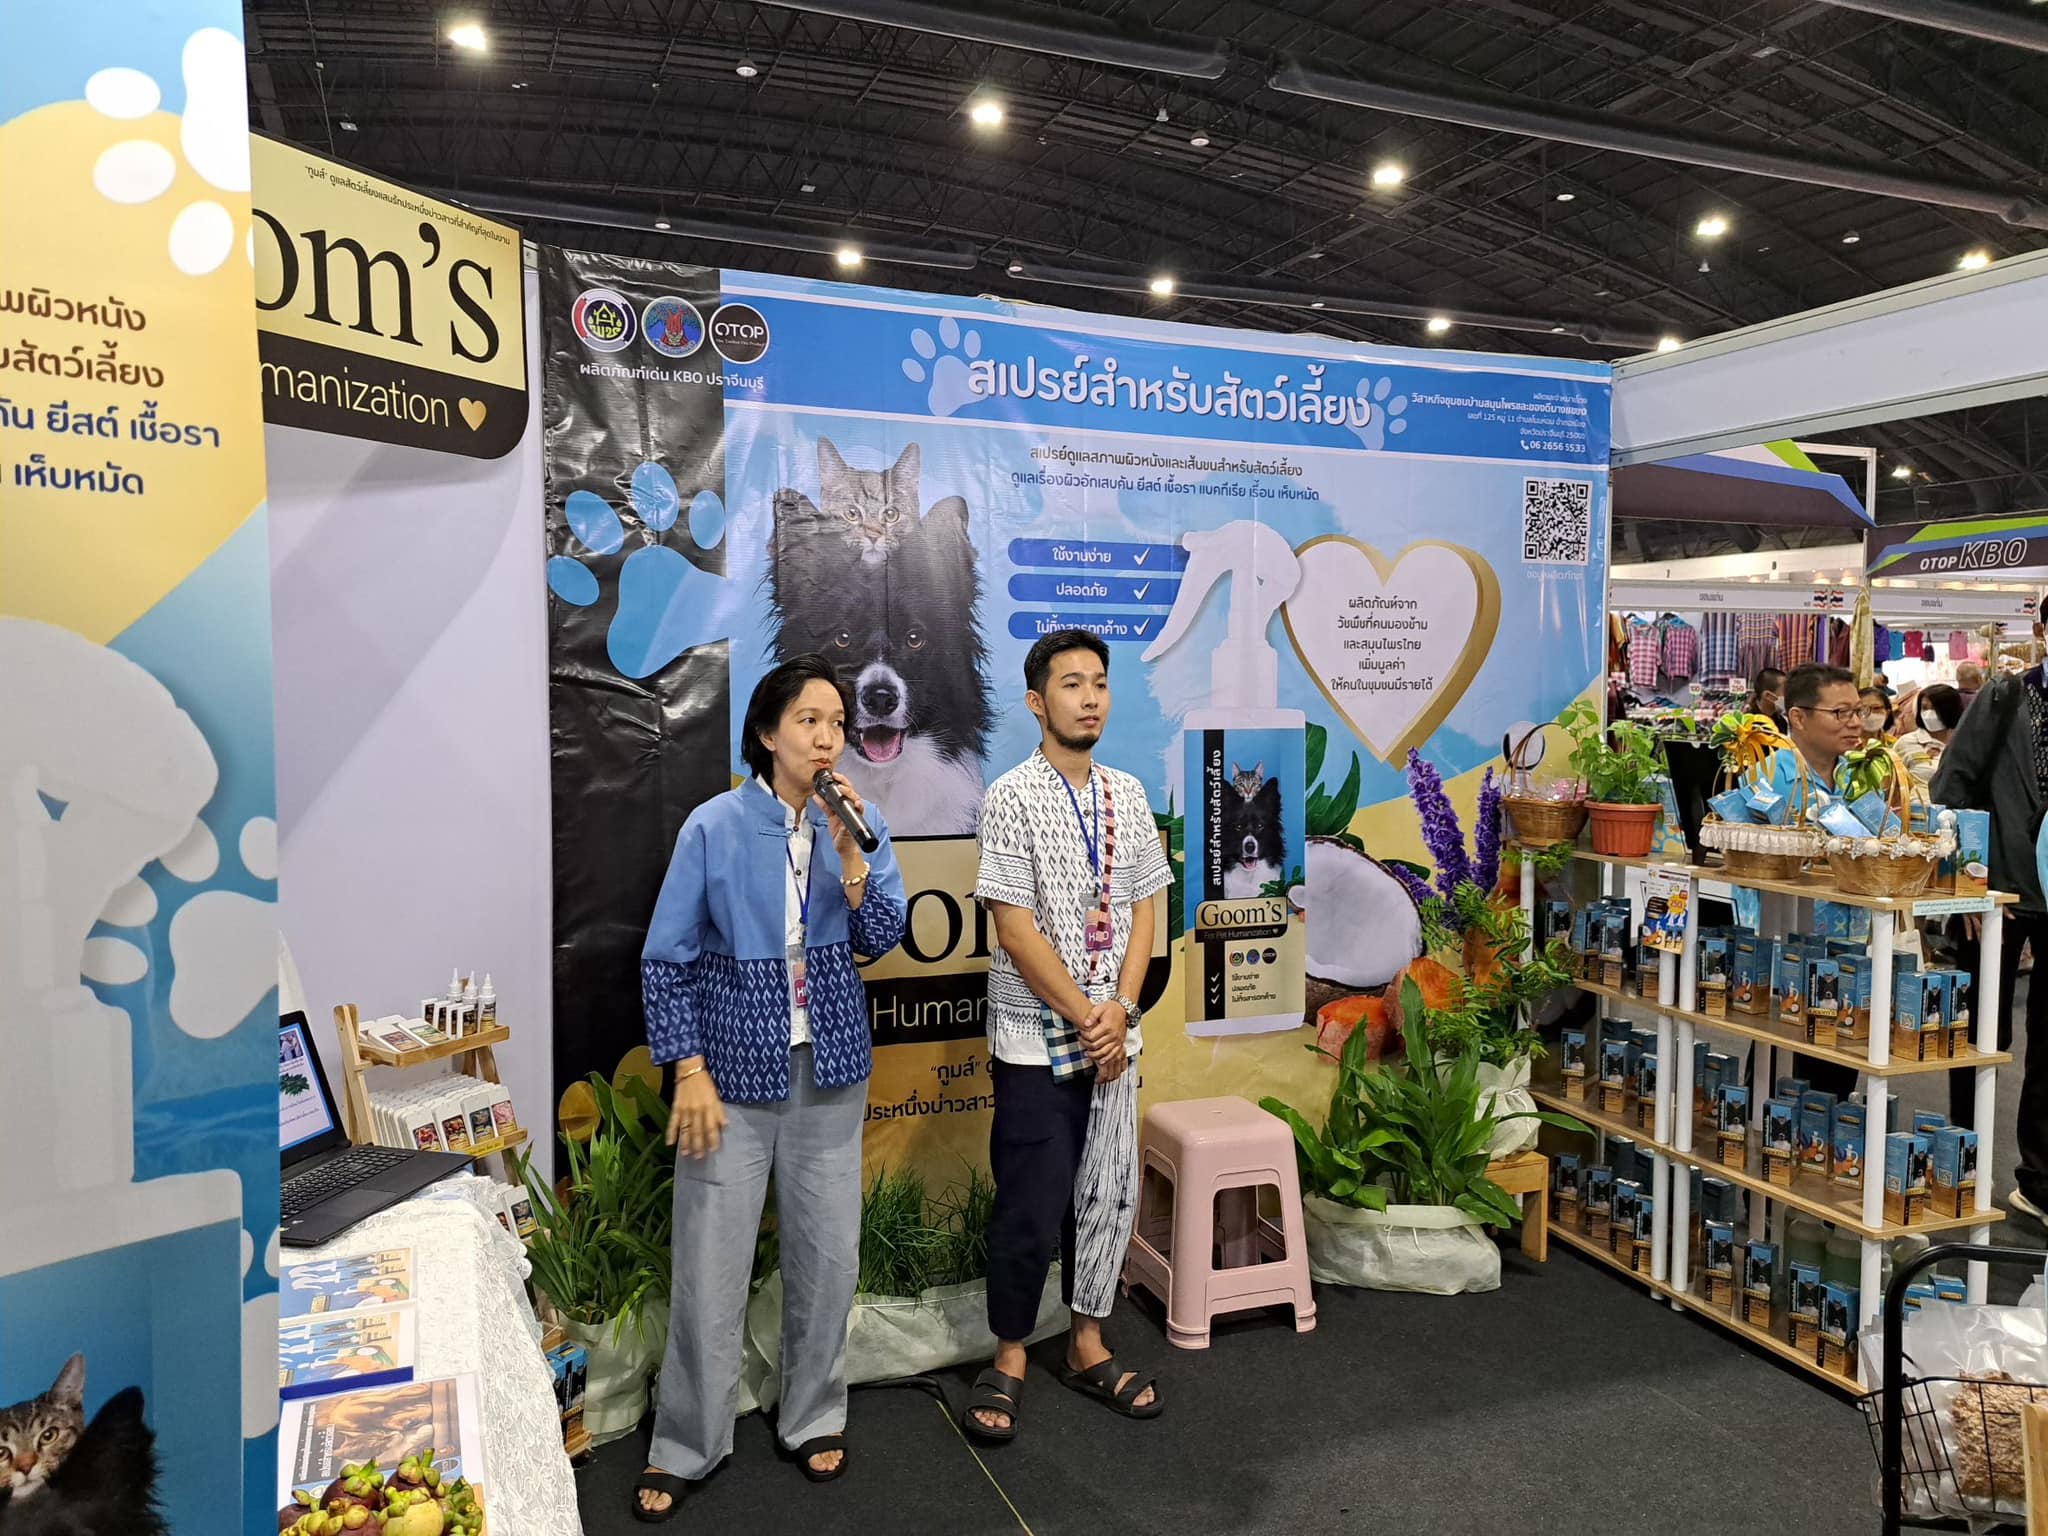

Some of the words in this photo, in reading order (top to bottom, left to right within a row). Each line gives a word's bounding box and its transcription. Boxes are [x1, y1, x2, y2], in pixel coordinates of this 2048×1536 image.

[714, 322, 765, 339] OTOP
[580, 362, 669, 382] ผลิตภัณฑ์เด่น
[673, 370, 704, 384] KBO
[706, 373, 764, 393] ปราจีนบุรี
[967, 354, 1374, 429] สเปรย์สำหรับสัตว์เลี้ยง
[46, 399, 119, 439] ยีสต์
[130, 399, 220, 448] เชื้อรา
[1529, 440, 1541, 449] 06
[1030, 445, 1303, 477] สเปรย์ดูแลสภาพผิวหนังและเส้นขนสำหรับสัตว์เลี้ยง
[14, 453, 145, 496] เห็บหมัด
[1011, 465, 1134, 490] ดูแลเรื่องผิวอักเสบคัน
[1137, 475, 1161, 492] ยีสต์
[1165, 473, 1196, 494] เชื้อรา
[1200, 481, 1247, 497] แบคทีเรีย
[1278, 484, 1320, 501] เห็บหมัด
[1052, 545, 1112, 563] ใช้งานง่าย
[1920, 556, 1958, 571] OTOP
[1958, 537, 2028, 569] KBO
[1056, 581, 1108, 597] ปลอดภัย
[1337, 611, 1428, 630] วัชพืชที่คนมองข้าม
[1343, 637, 1422, 655] และสมุนไพรไทย
[1358, 652, 1406, 675] เพิ่มมูลค่า
[1331, 676, 1433, 695] ให้คนในชุมชนมีรายได้
[1206, 749, 1222, 886] สเปรย์สำหรับสัตว์เลี้ยง
[1201, 901, 1283, 927] Goom's
